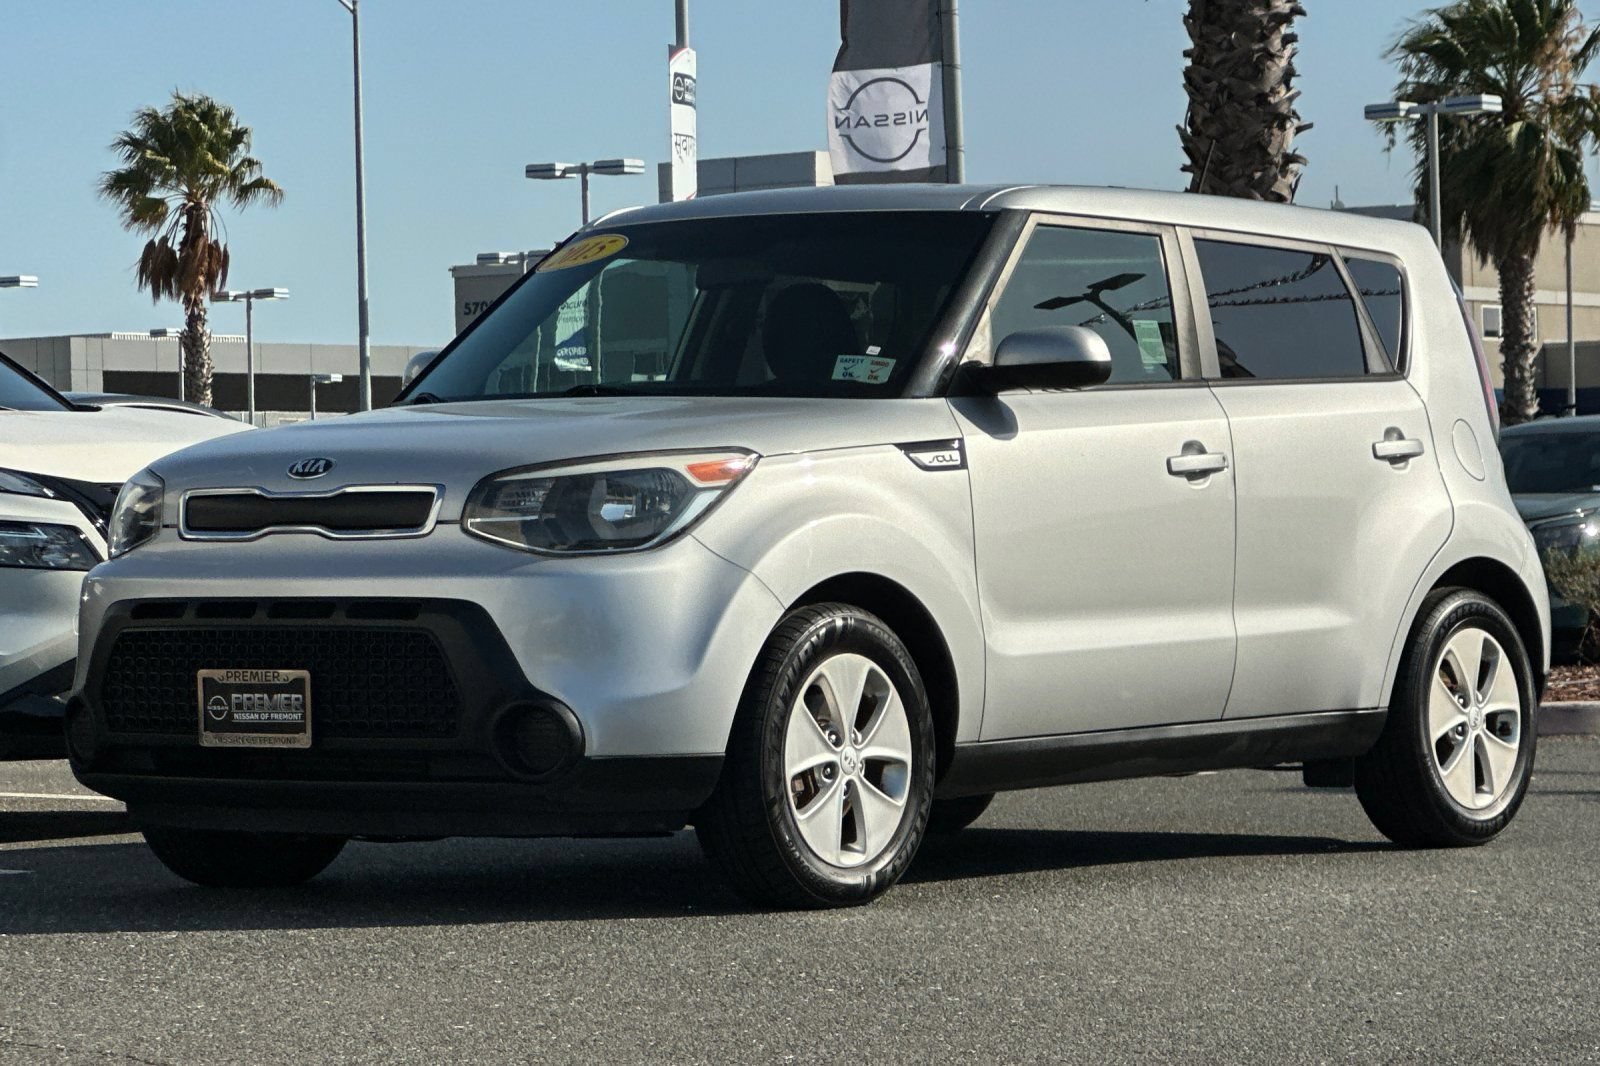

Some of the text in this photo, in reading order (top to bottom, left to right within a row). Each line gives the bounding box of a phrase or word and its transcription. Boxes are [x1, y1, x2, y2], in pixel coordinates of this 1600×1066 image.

[463, 300, 494, 316] 570
[839, 357, 866, 365] SAFETY
[291, 459, 328, 473] KIA
[225, 670, 281, 682] PREMIER
[231, 693, 304, 711] PREMIER
